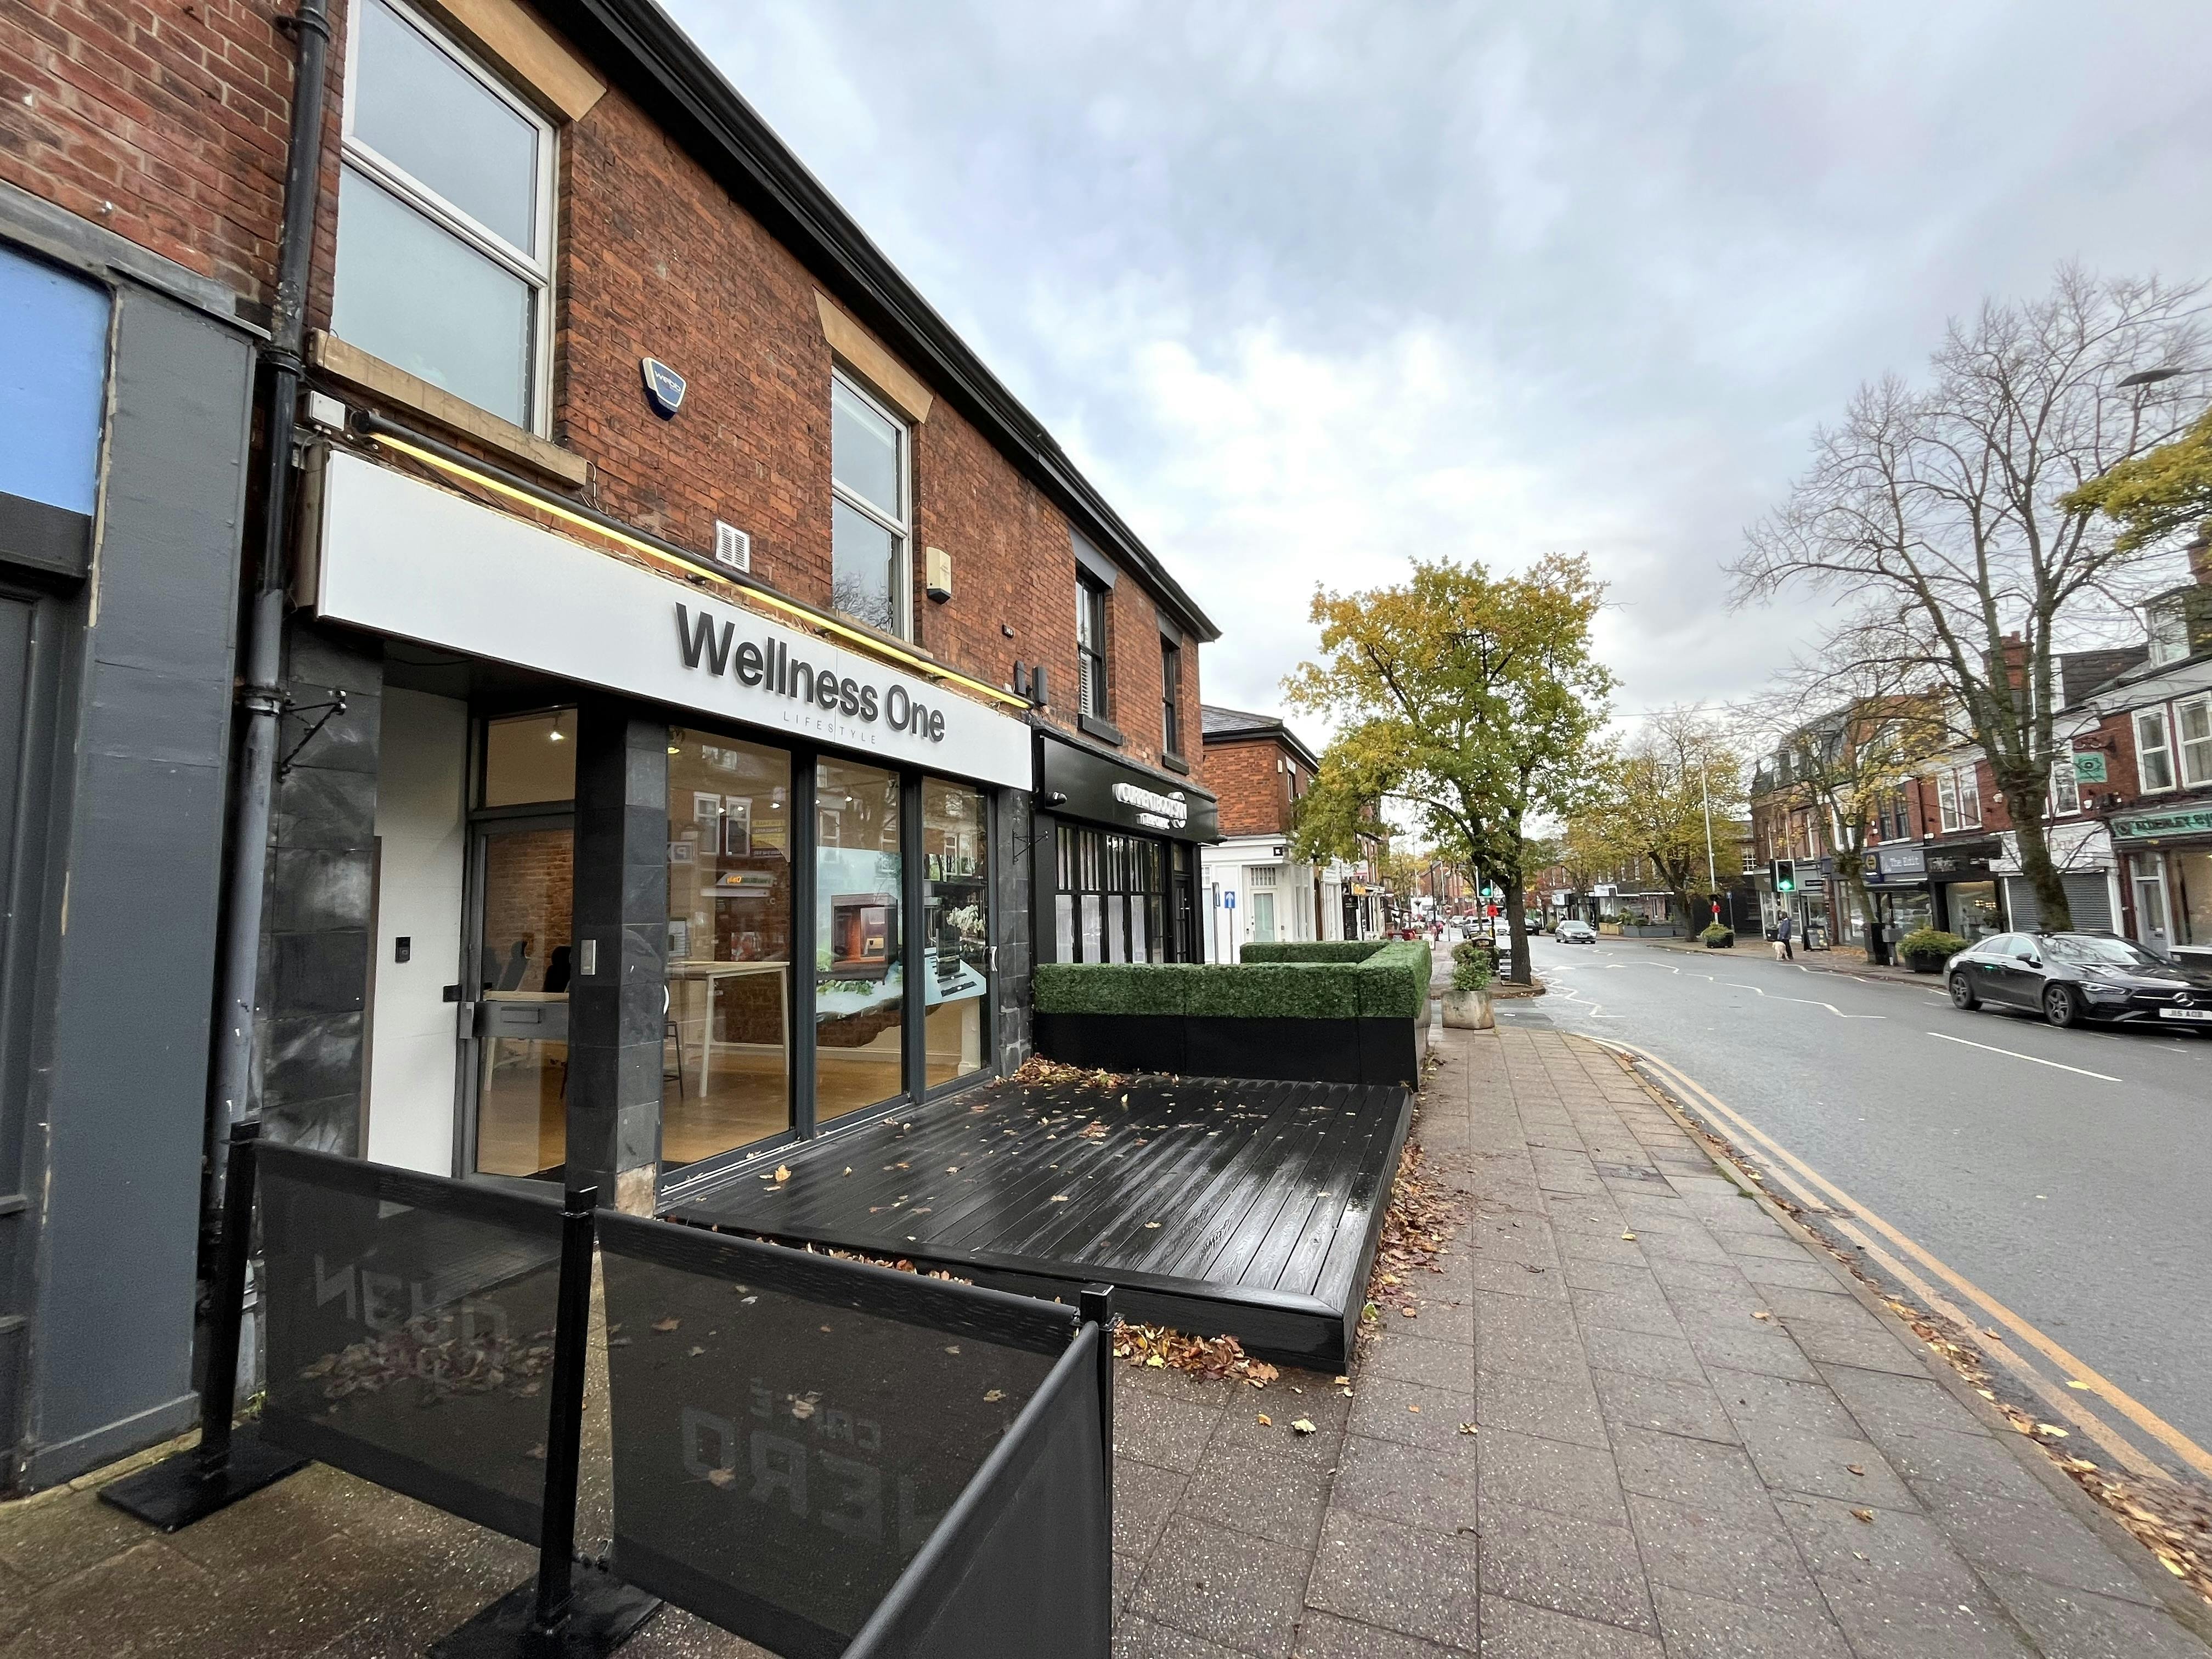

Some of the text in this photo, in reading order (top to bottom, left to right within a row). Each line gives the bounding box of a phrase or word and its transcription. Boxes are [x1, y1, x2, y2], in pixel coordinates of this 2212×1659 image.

[675, 601, 945, 743] Wellness One
[783, 710, 876, 744] LIFESTYLE
